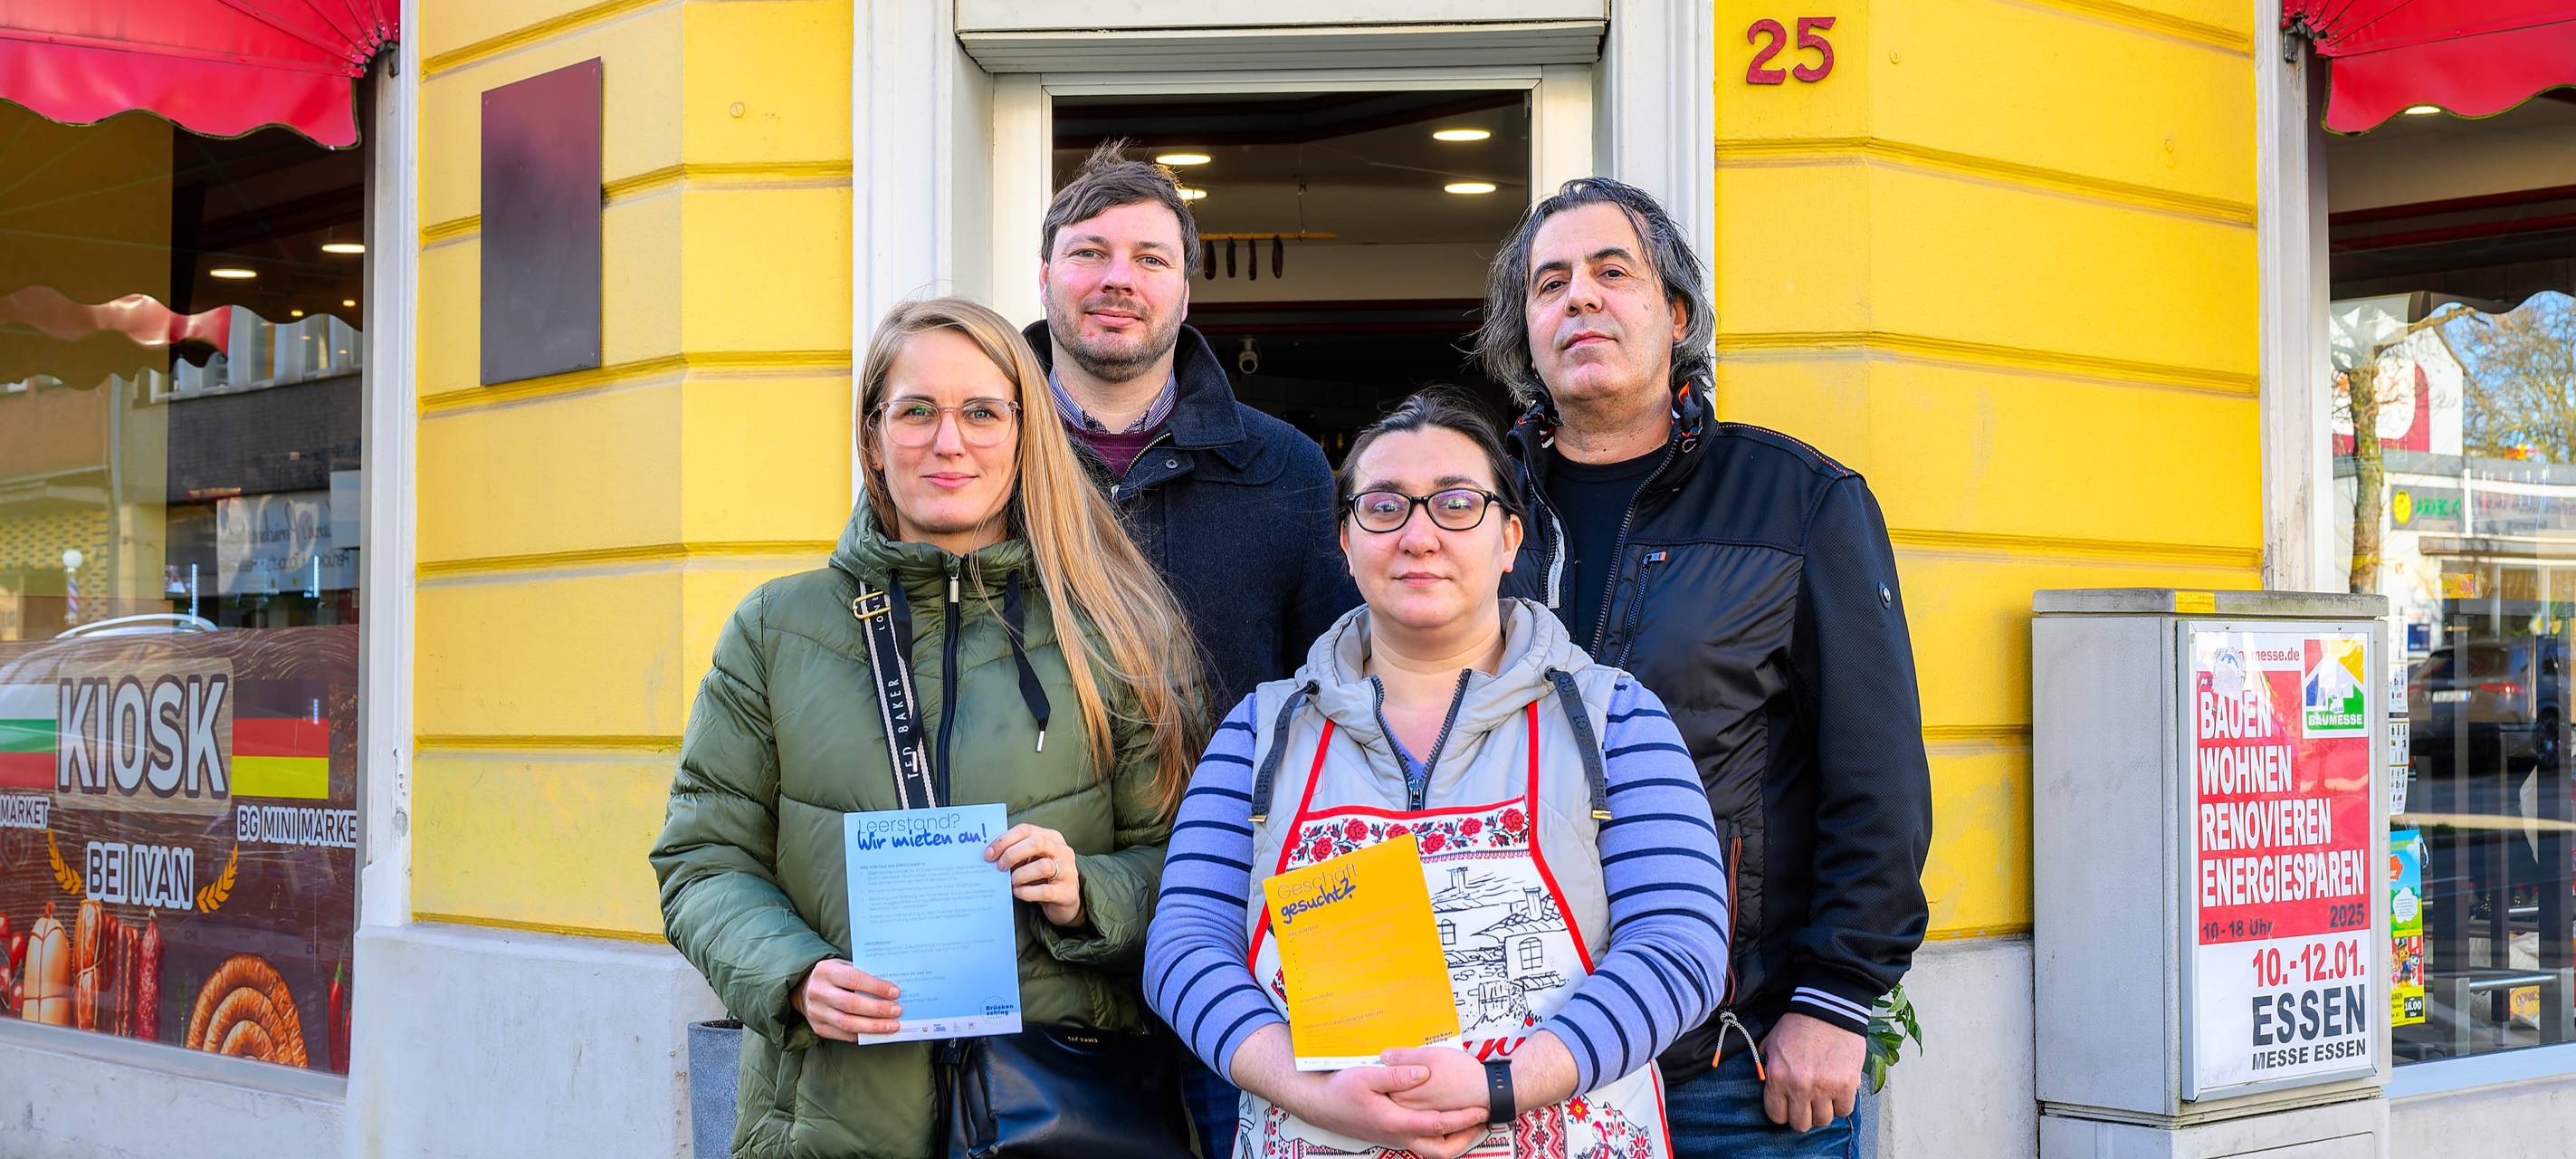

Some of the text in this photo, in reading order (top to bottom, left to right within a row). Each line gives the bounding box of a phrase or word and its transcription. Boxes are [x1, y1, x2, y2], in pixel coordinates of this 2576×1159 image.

[1746, 16, 1837, 85] 25
[888, 678, 909, 733] BAKER
[2200, 691, 2273, 740] BAUEN
[59, 674, 228, 800] KIOSK
[2199, 745, 2292, 795] WOHNEN
[0, 798, 49, 827] MARKET
[238, 807, 259, 839] BG
[262, 809, 297, 842] MINI
[857, 822, 987, 850] Wir mieten an!
[858, 813, 960, 834] Leerstand?
[2200, 798, 2332, 851] RENOVIEREN
[88, 844, 192, 908] BEI IVAN
[1281, 876, 1357, 924] gesucht?
[2202, 849, 2365, 908] ENERGIESPAREN
[2203, 922, 2218, 941] 10
[2228, 920, 2244, 938] 18
[2249, 918, 2274, 936] Uhr
[2330, 903, 2365, 928] 2025
[2252, 983, 2366, 1047] ESSEN
[2252, 1039, 2366, 1070] MESSE ESSEN
